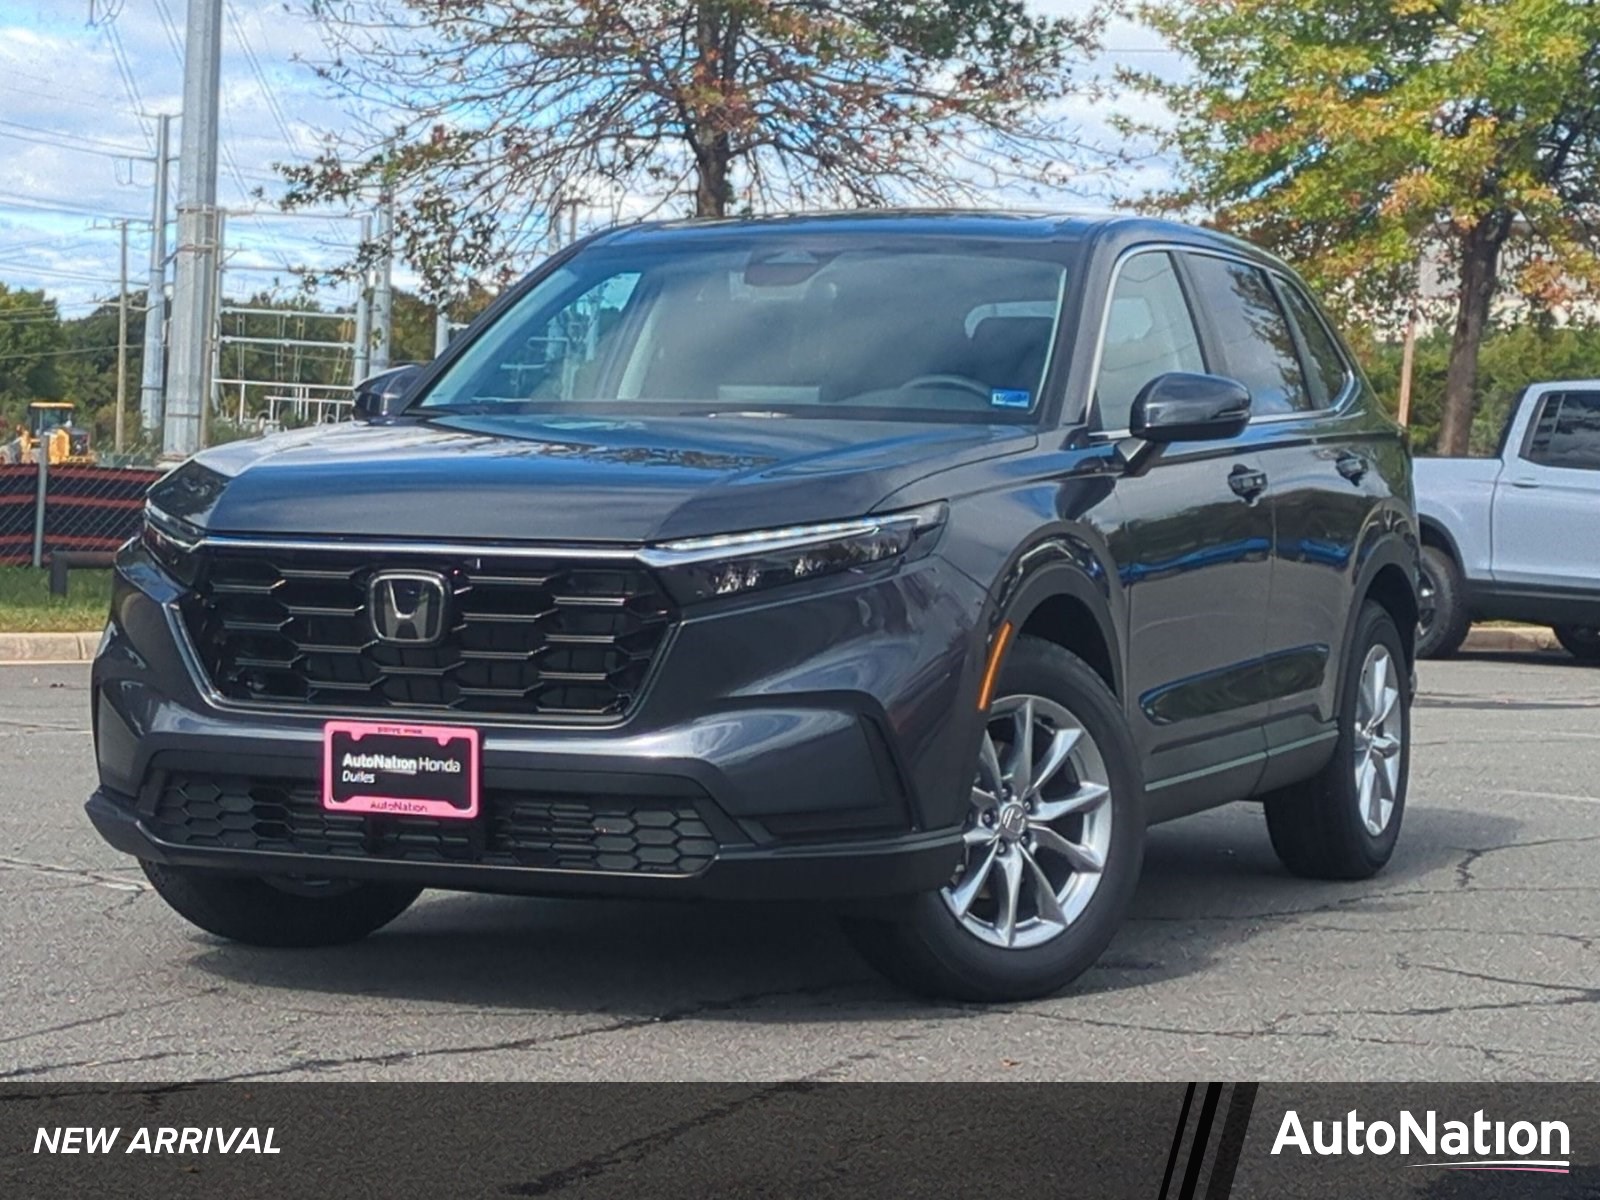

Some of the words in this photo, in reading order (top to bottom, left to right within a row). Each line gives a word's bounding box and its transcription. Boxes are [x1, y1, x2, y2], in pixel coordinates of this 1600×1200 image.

[342, 752, 417, 770] AutoNation
[418, 756, 461, 773] Honda
[370, 801, 427, 812] AutoNation
